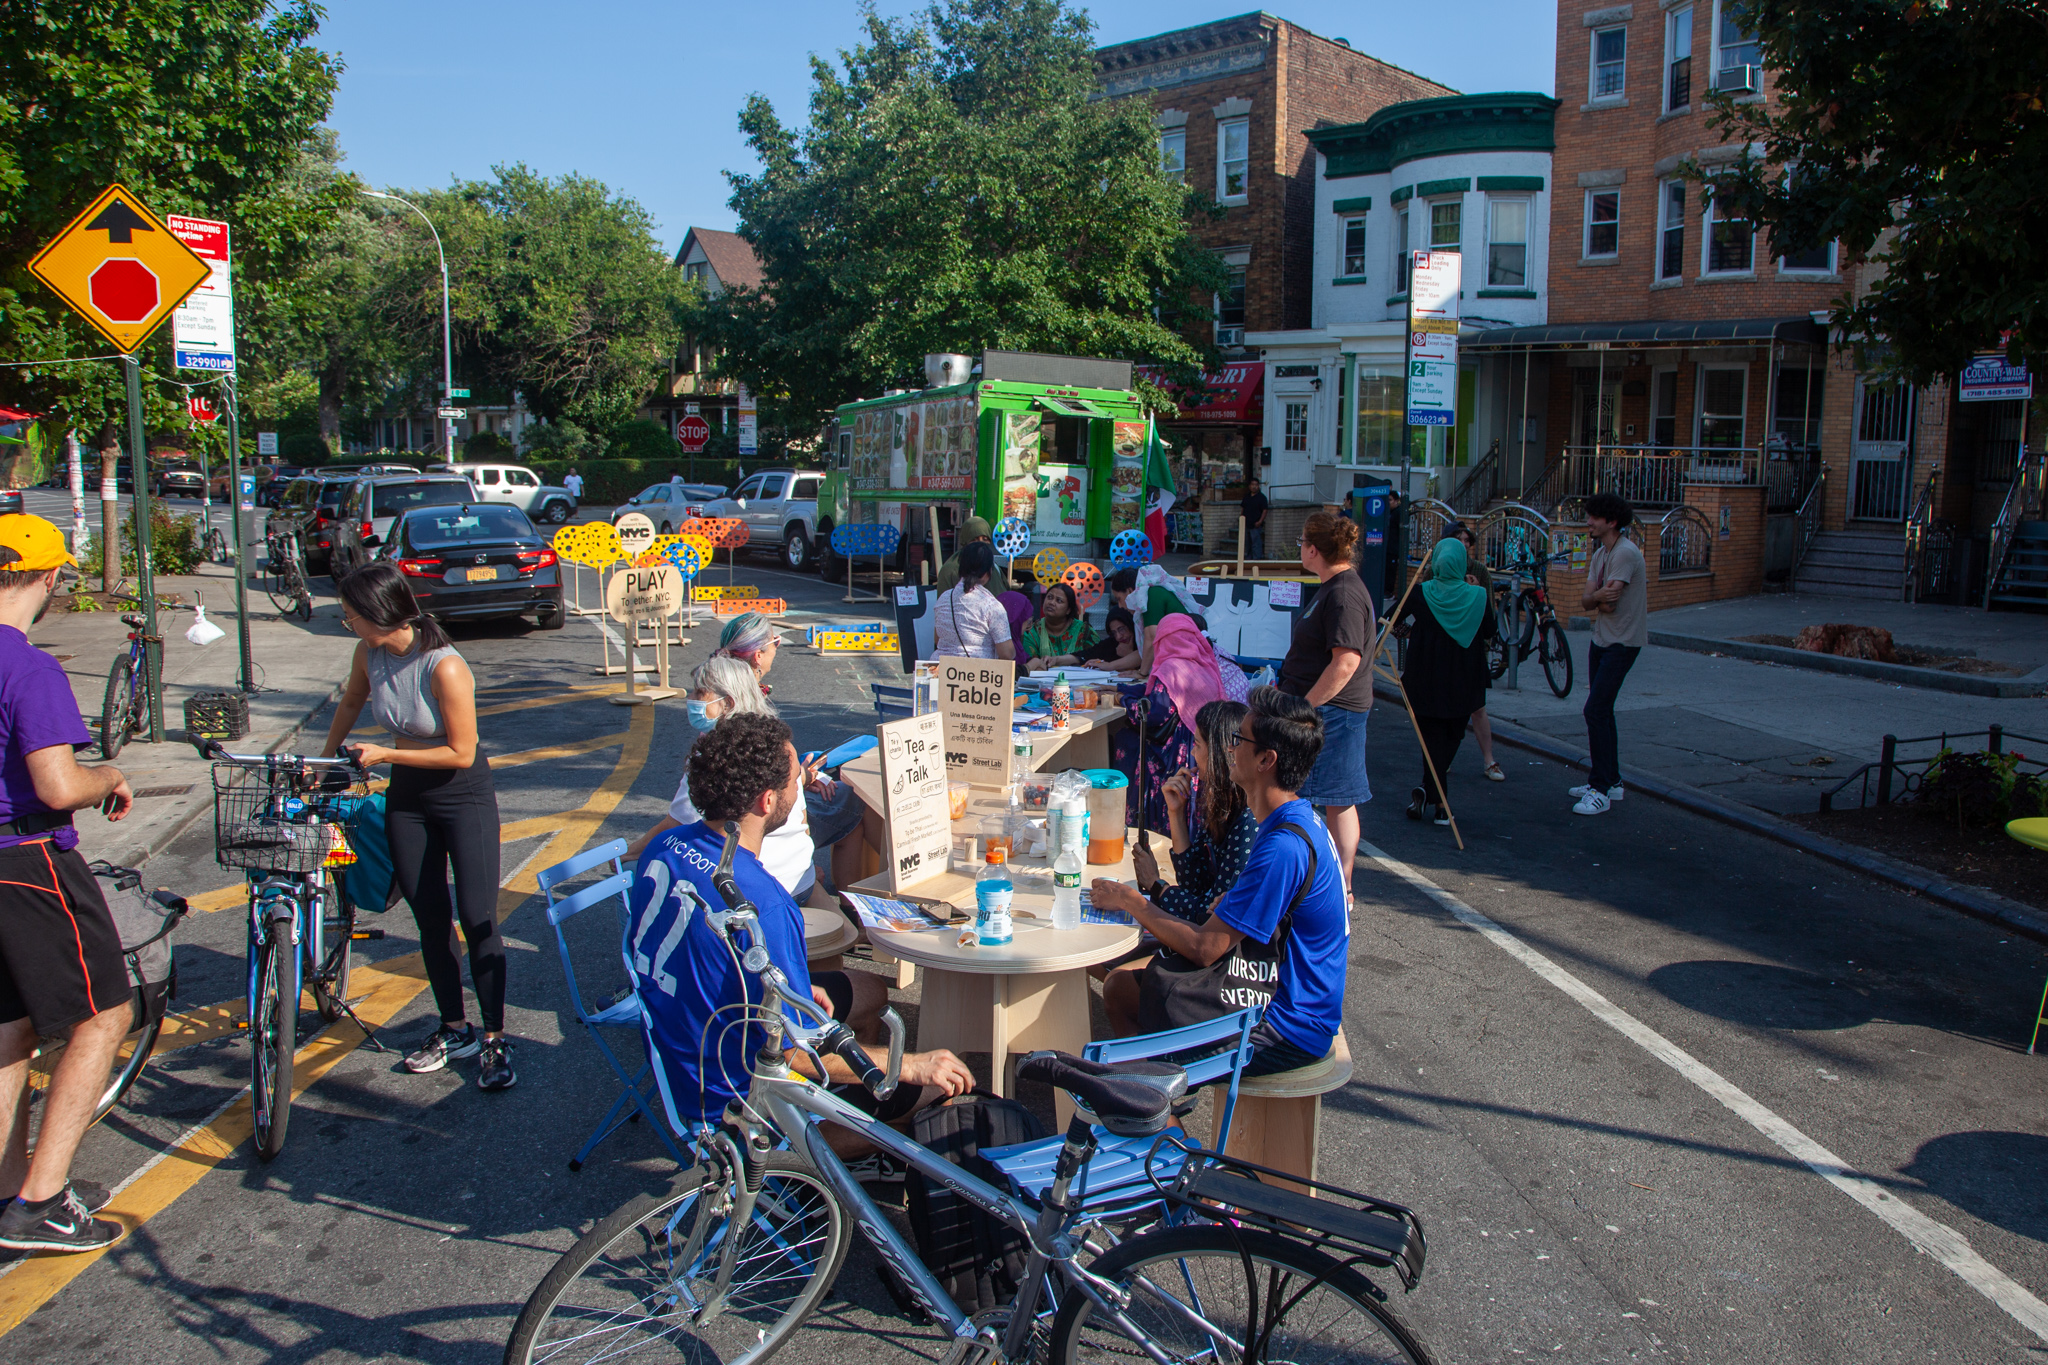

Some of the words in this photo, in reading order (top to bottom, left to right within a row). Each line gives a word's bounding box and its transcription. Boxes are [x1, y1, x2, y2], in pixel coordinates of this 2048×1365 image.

[172, 220, 183, 229] NO
[184, 222, 220, 234] STANDING
[174, 230, 204, 241] Anytime
[186, 356, 220, 368] 329901
[1415, 363, 1422, 375] 2
[1965, 366, 2026, 379] COUNTRY-WIDE
[1410, 415, 1436, 423] 306623
[680, 426, 707, 438] STOP
[244, 483, 251, 492] P
[1372, 499, 1381, 514] P
[1068, 508, 1081, 518] chi
[1063, 518, 1085, 526] cken
[620, 528, 650, 538] NYC
[627, 570, 667, 593] PLAY
[656, 592, 671, 603] NYC.
[946, 667, 975, 682] One
[980, 670, 1003, 688] Big
[946, 684, 1001, 706] Table
[952, 723, 994, 734] 一張大桌子
[905, 739, 924, 755] Tea
[914, 756, 919, 764] +
[972, 757, 990, 766] Street
[906, 765, 929, 784] Talk
[897, 839, 911, 849] Carnival
[921, 831, 932, 839] Market
[663, 835, 687, 854] NYC
[683, 848, 719, 874] FOOT
[928, 849, 939, 860] Street
[900, 852, 920, 872] NYC
[633, 860, 697, 997] 22
[945, 1178, 986, 1206] Cypress
[989, 1206, 1011, 1219] DX
